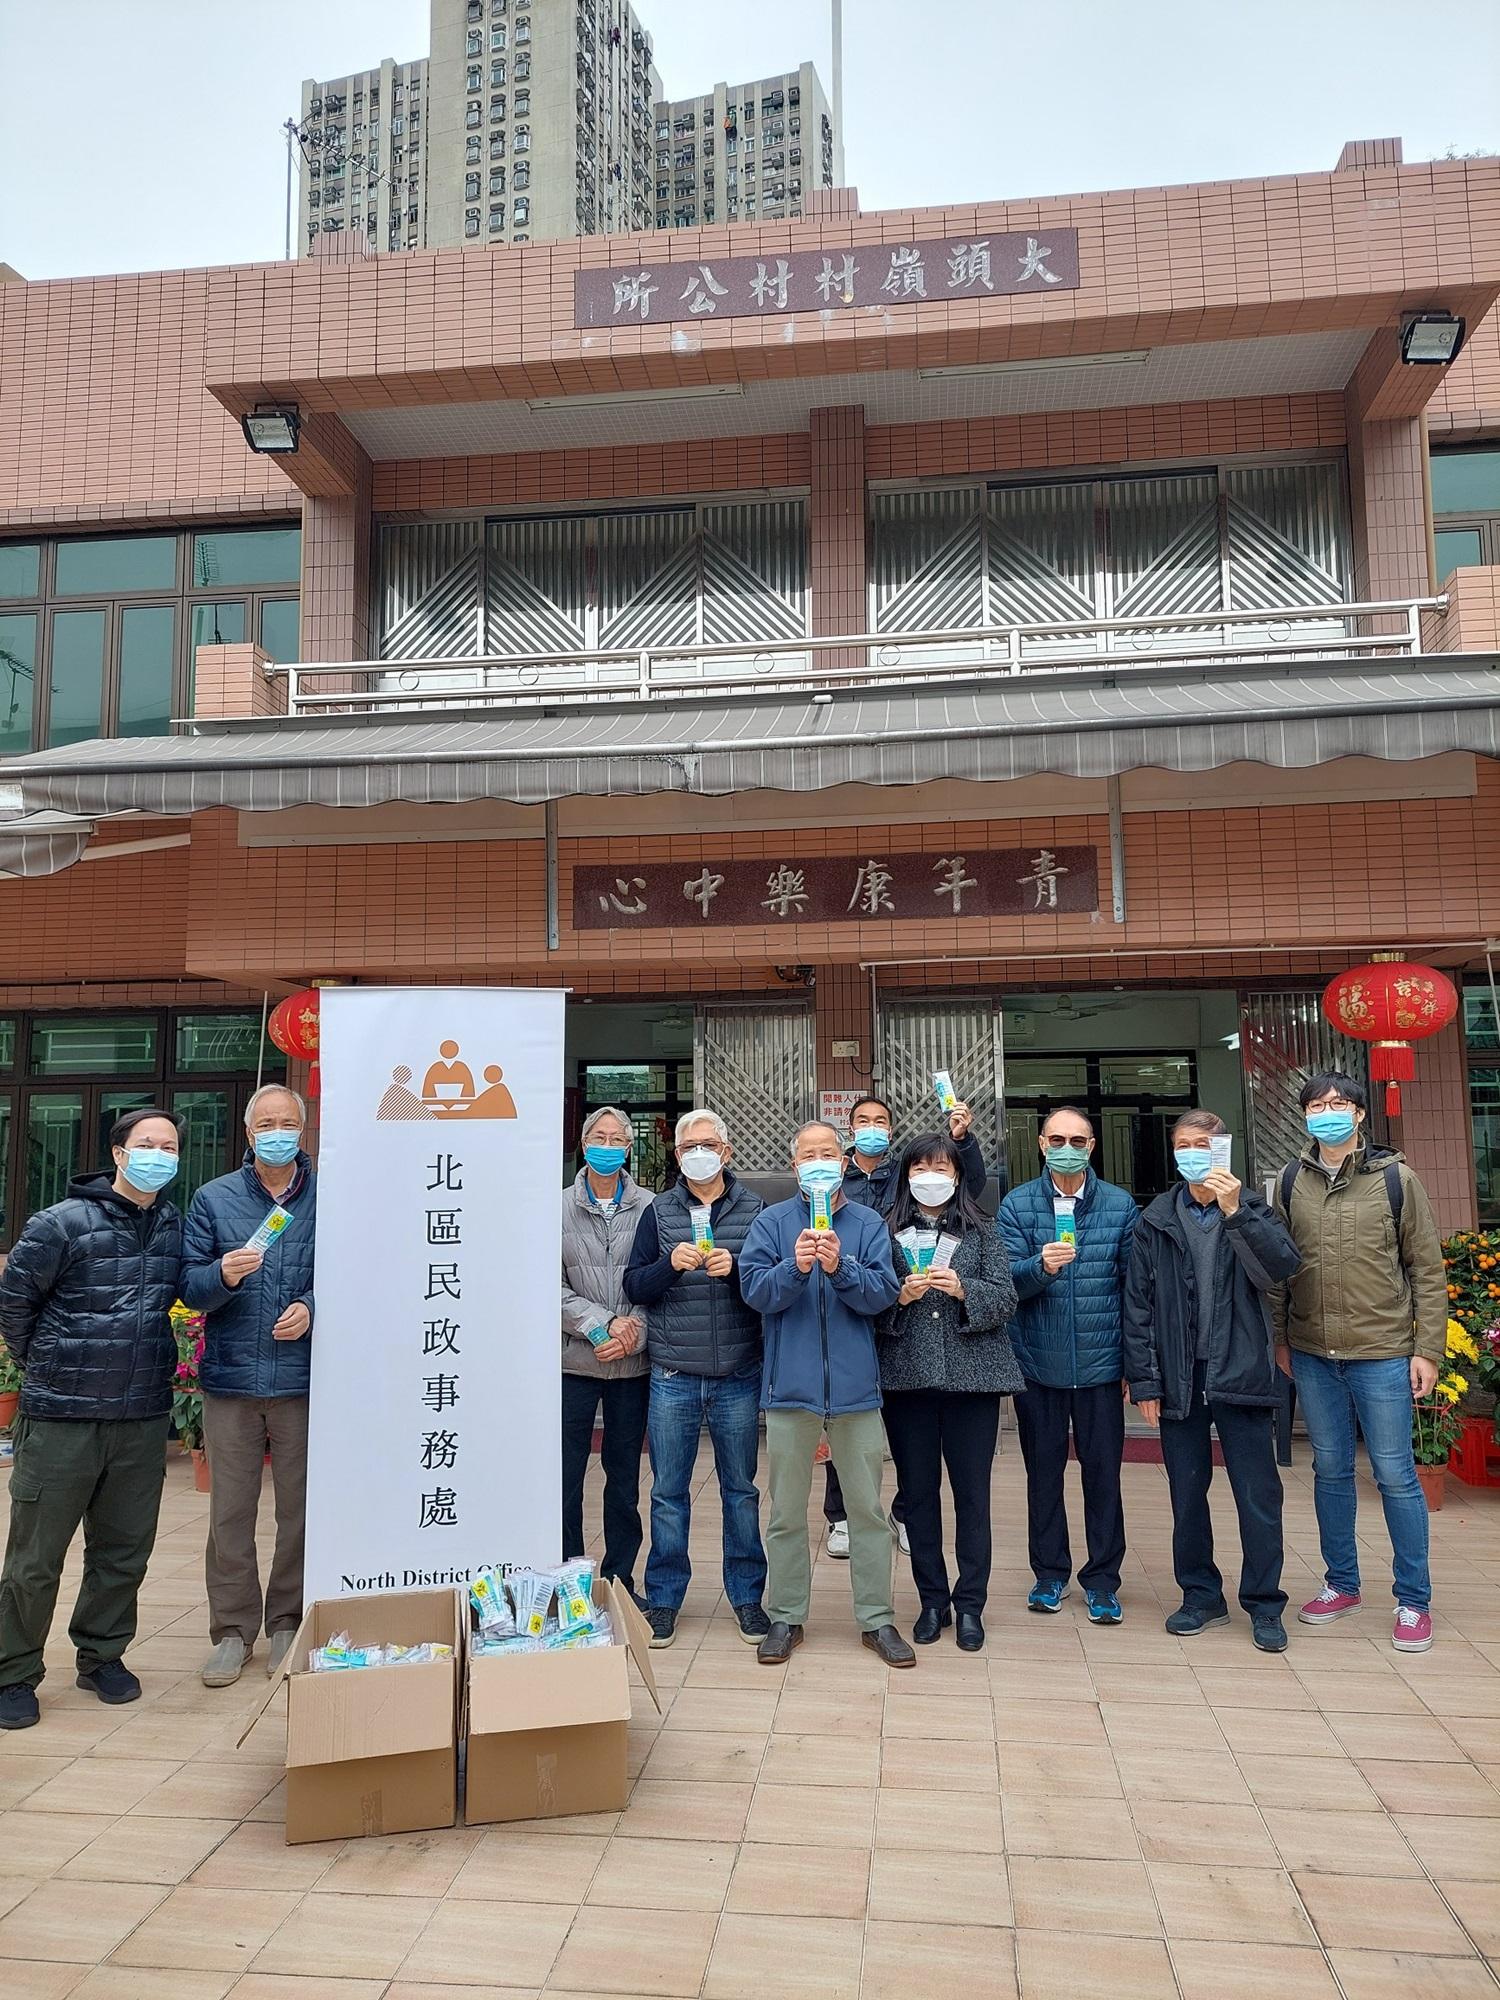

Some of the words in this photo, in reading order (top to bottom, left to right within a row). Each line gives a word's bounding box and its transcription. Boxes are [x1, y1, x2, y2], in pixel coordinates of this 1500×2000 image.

[612, 237, 1062, 319] 大頭嶺村村公所
[599, 849, 1069, 917] 青年康樂中心
[418, 1153, 464, 1529] 北區民政事務處
[341, 1571, 395, 1592] North
[403, 1567, 471, 1587] District
